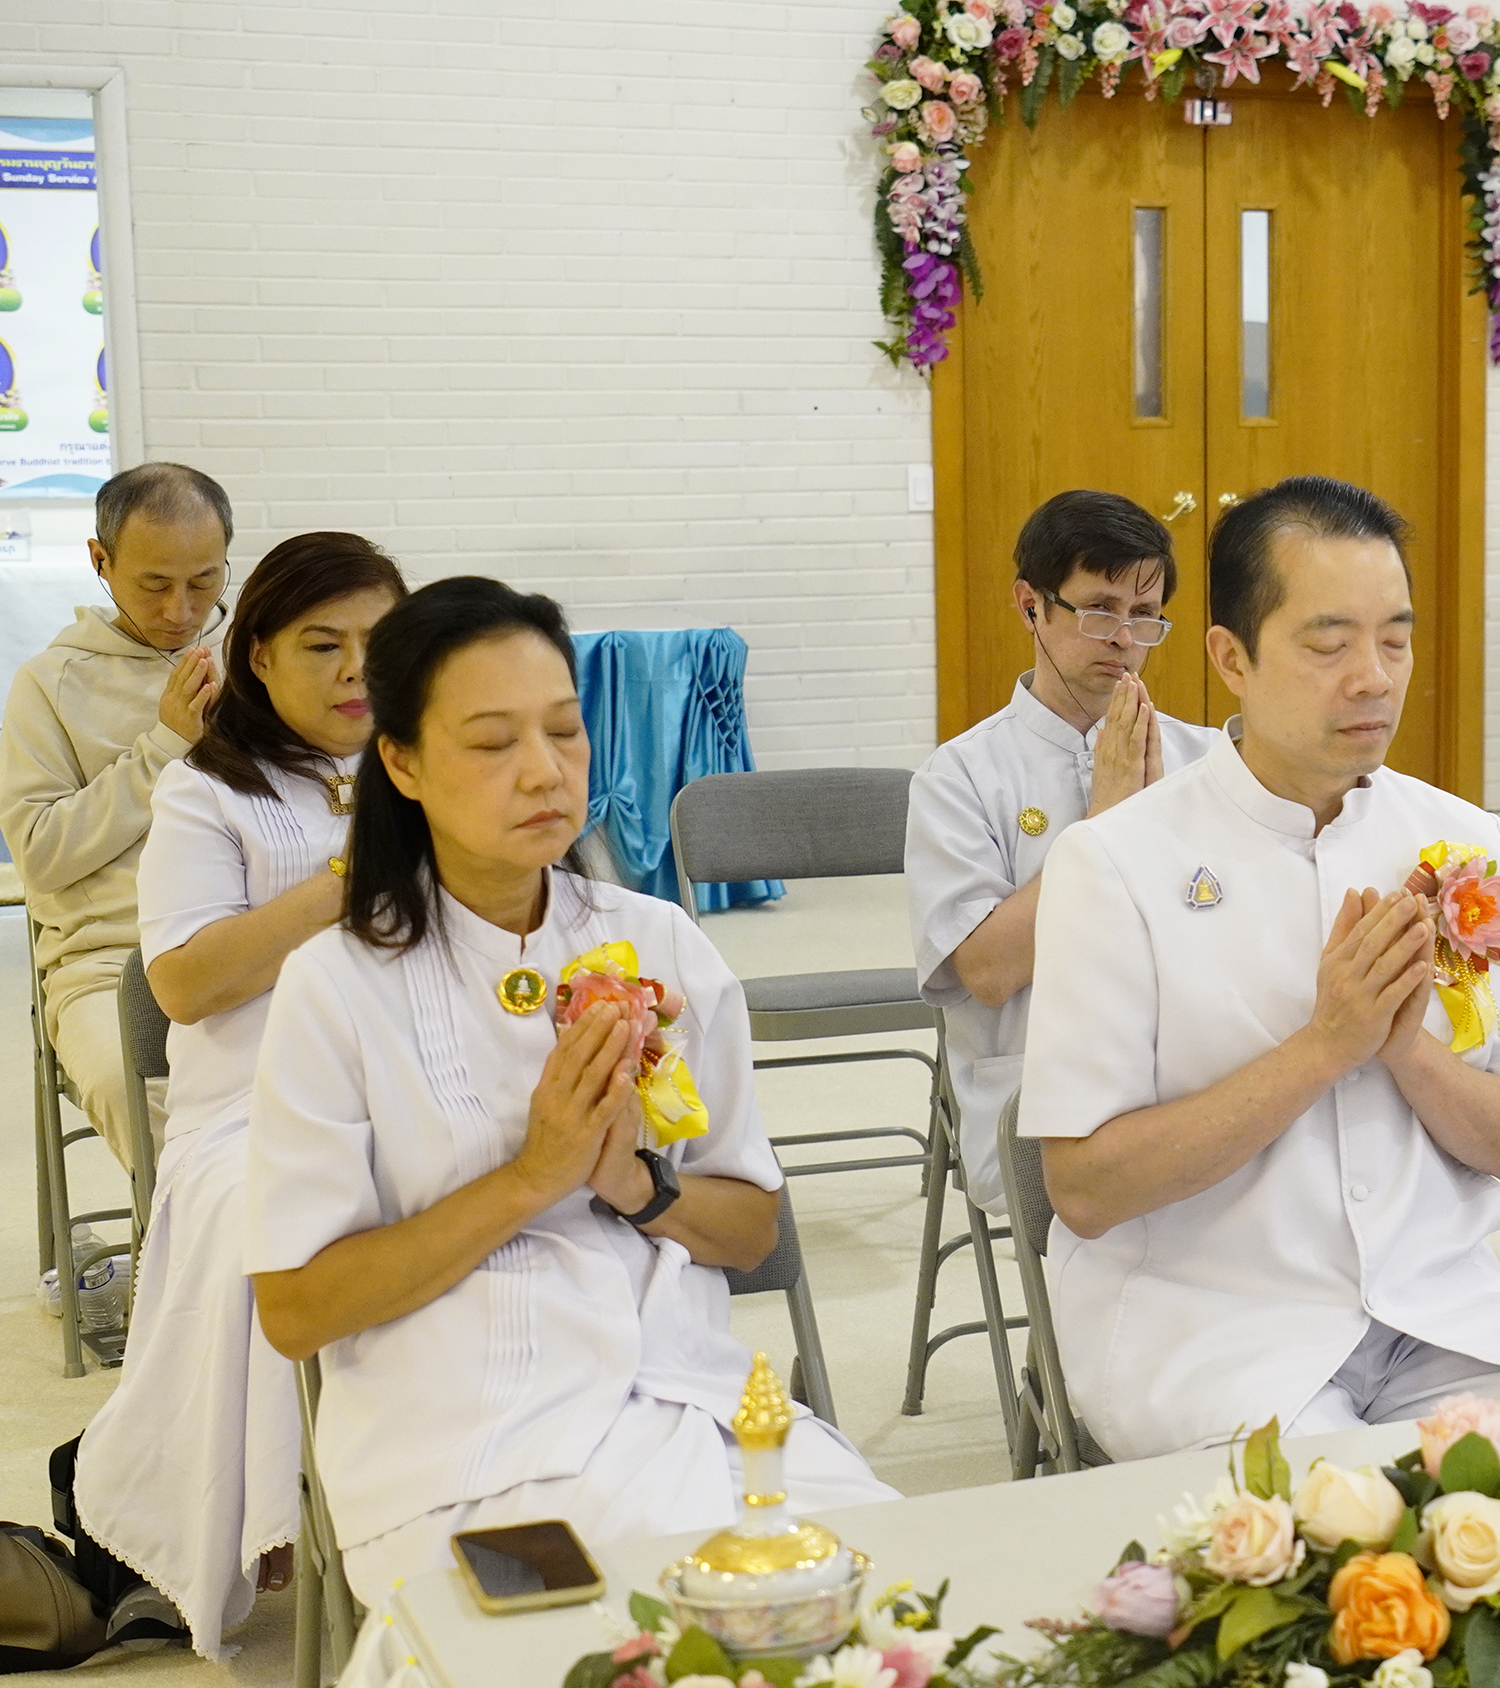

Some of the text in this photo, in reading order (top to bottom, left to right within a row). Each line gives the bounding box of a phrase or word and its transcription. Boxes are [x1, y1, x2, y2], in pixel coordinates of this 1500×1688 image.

[2, 172, 45, 185] Sunday
[47, 173, 90, 185] Service
[20, 458, 60, 467] Buddhist
[64, 458, 102, 467] tradition
